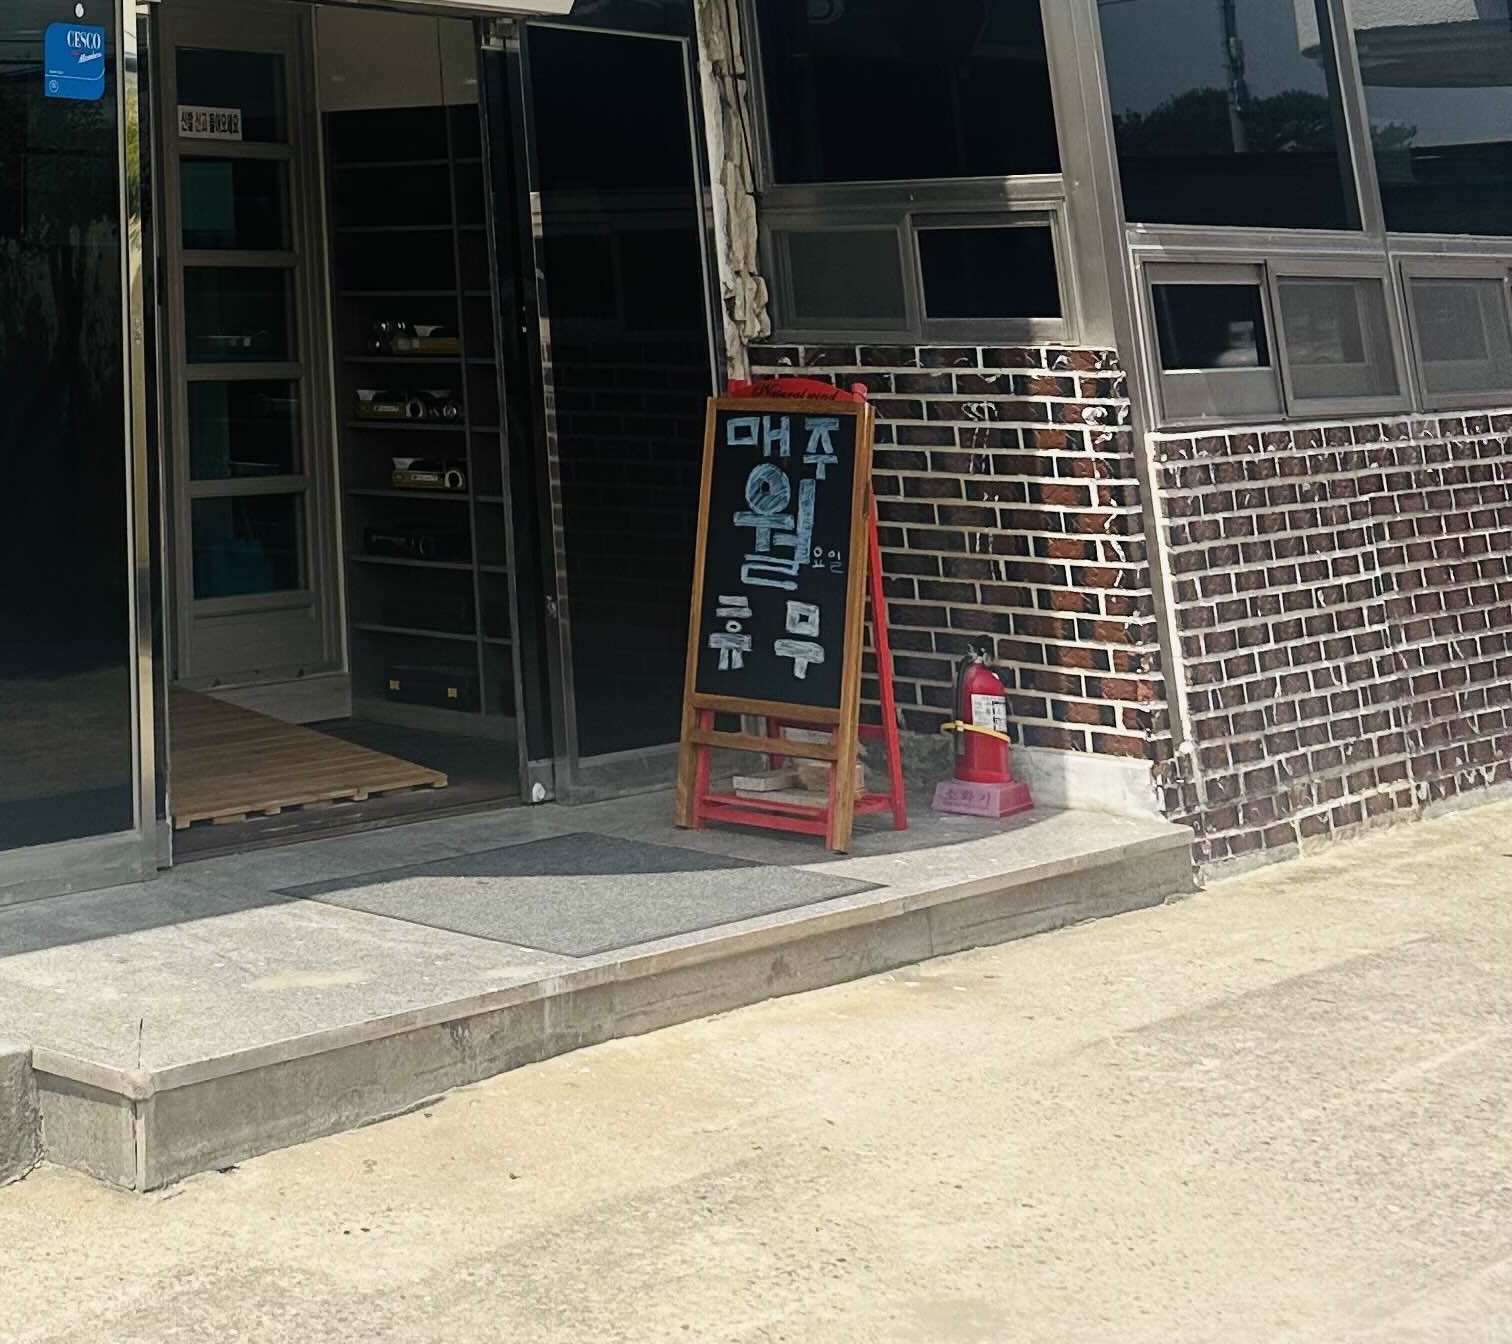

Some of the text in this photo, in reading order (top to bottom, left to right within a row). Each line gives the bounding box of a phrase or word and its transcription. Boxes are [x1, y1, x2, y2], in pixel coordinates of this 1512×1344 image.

[67, 30, 101, 49] CESCO
[726, 415, 841, 480] 매주
[707, 594, 826, 680] 휴무
